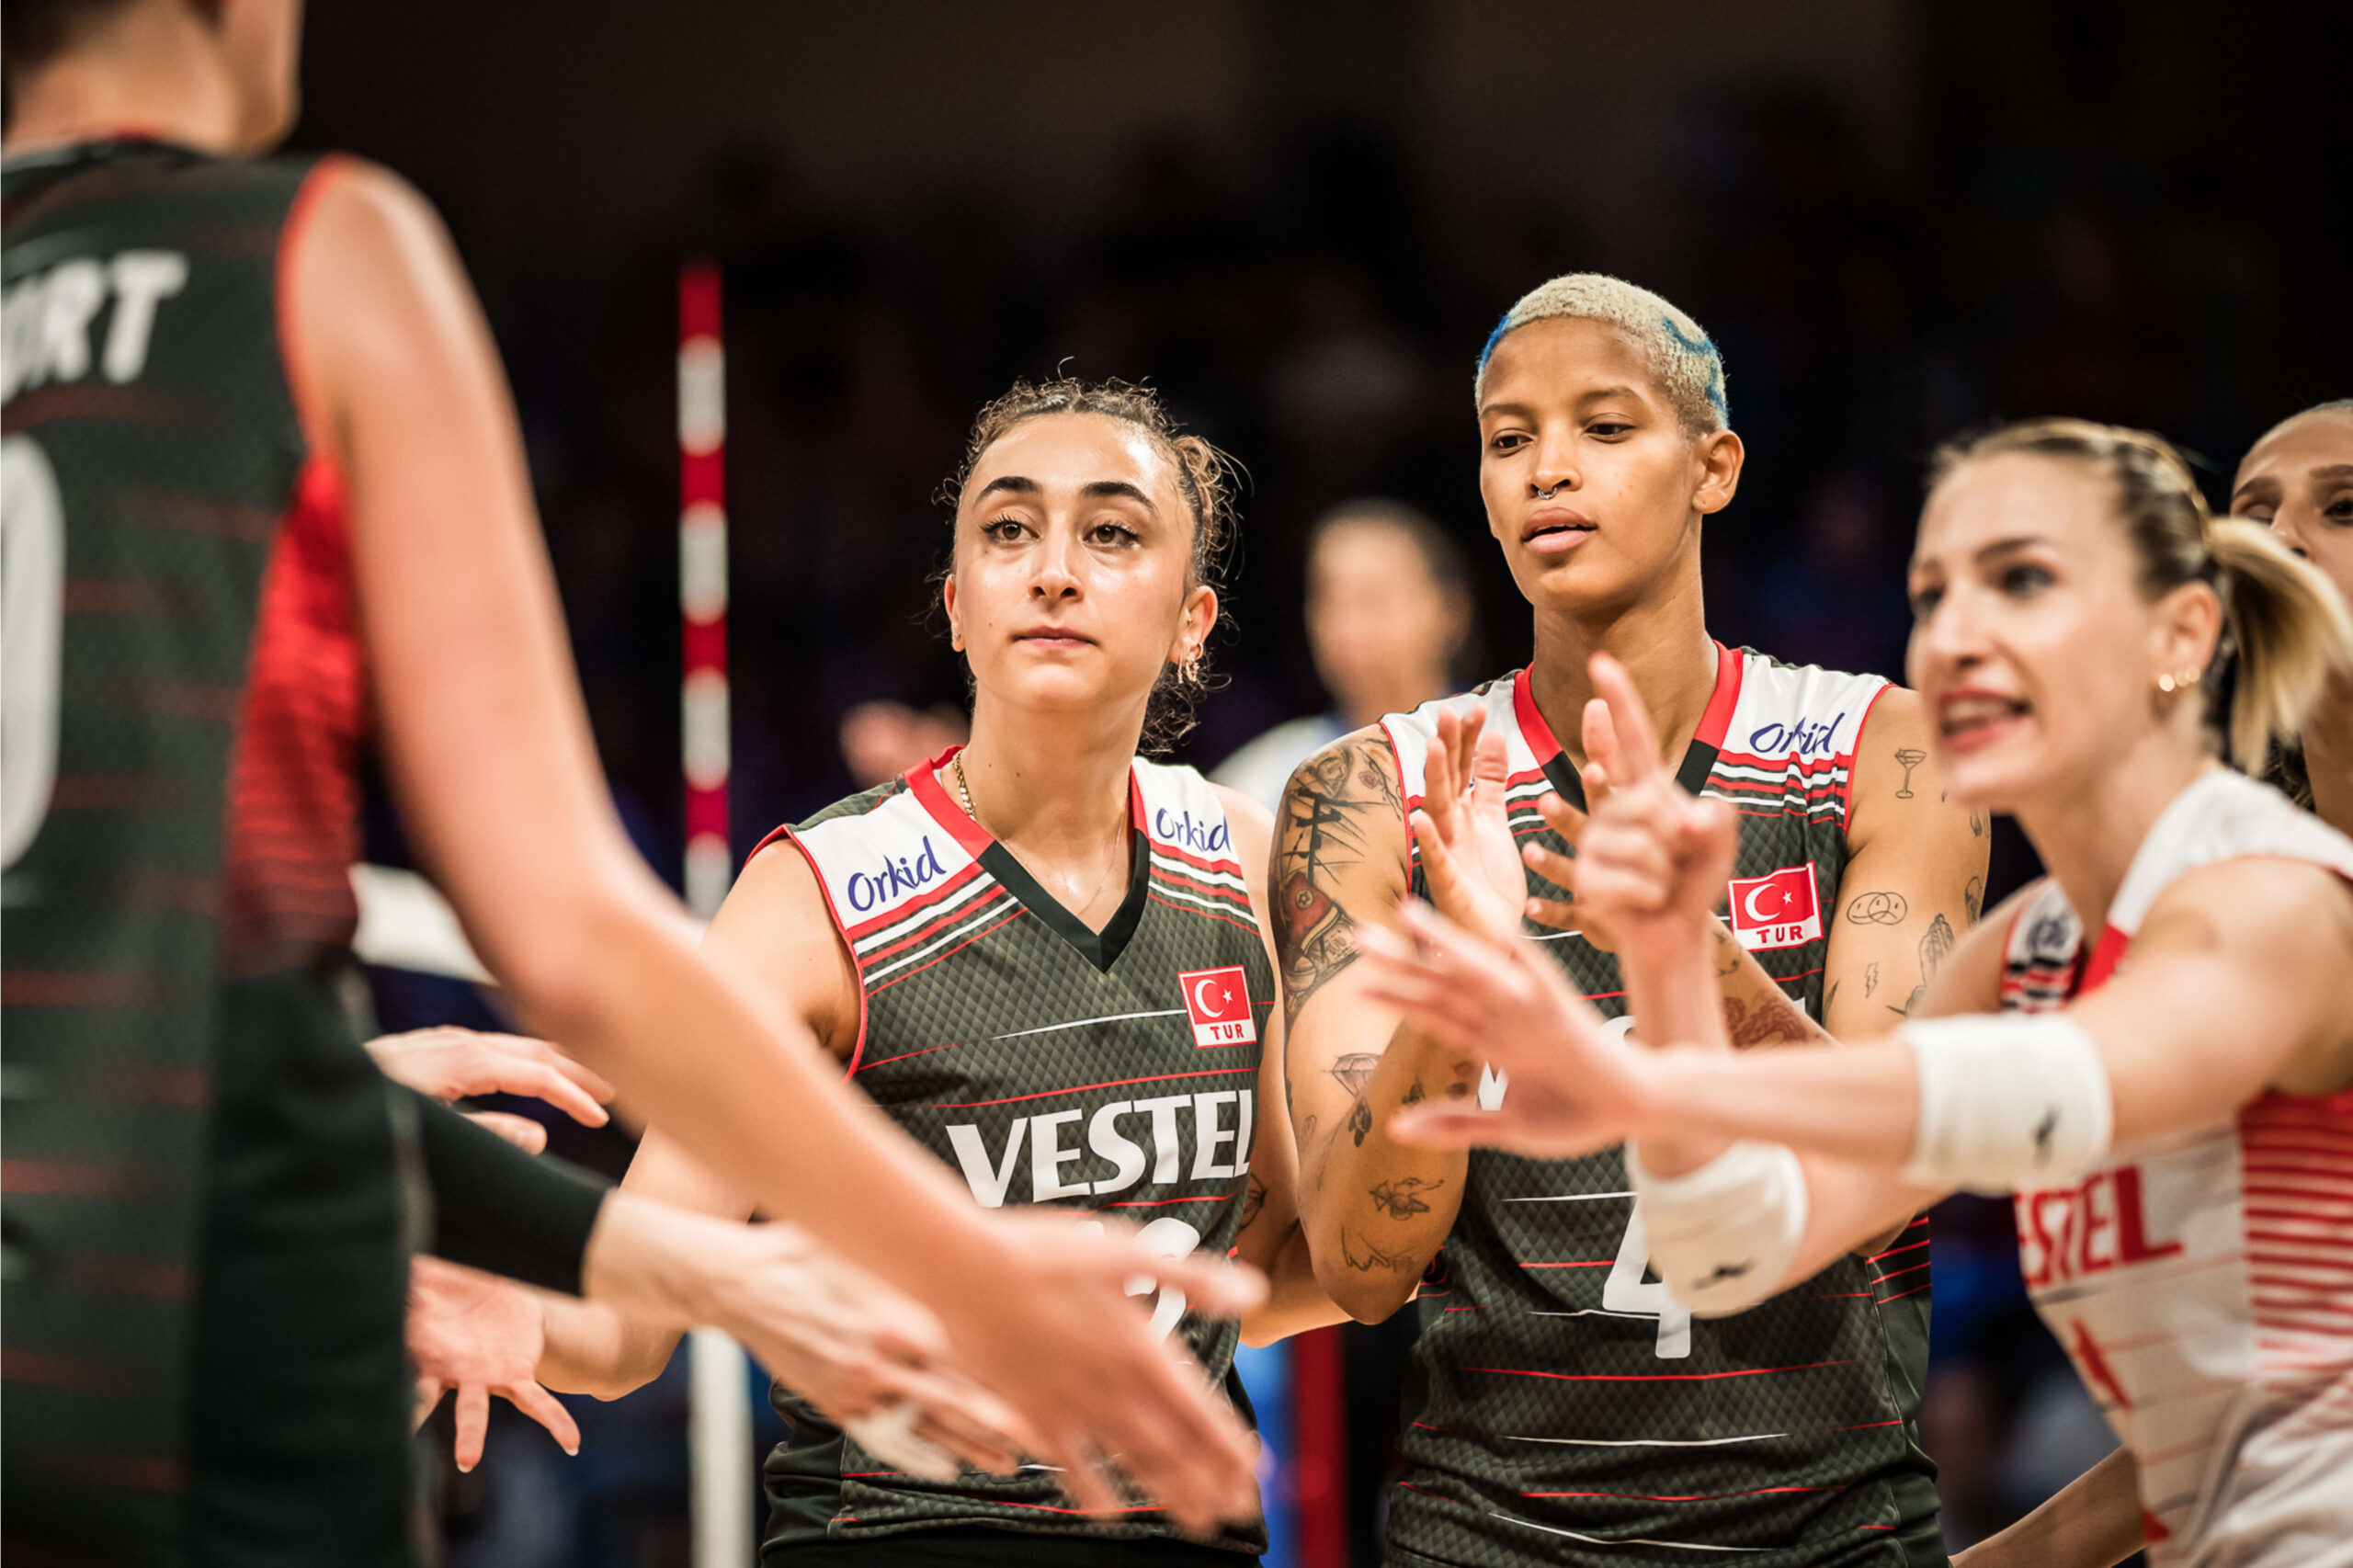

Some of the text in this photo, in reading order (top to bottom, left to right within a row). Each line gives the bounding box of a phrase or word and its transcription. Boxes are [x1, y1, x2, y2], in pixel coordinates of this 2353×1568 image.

[1155, 807, 1232, 853] Orkid
[847, 835, 947, 912] Orkid
[1756, 925, 1803, 944] TUR
[1210, 1023, 1245, 1041] TUR
[945, 1088, 1253, 1209] VESTEL
[2014, 1165, 2187, 1289] STEL
